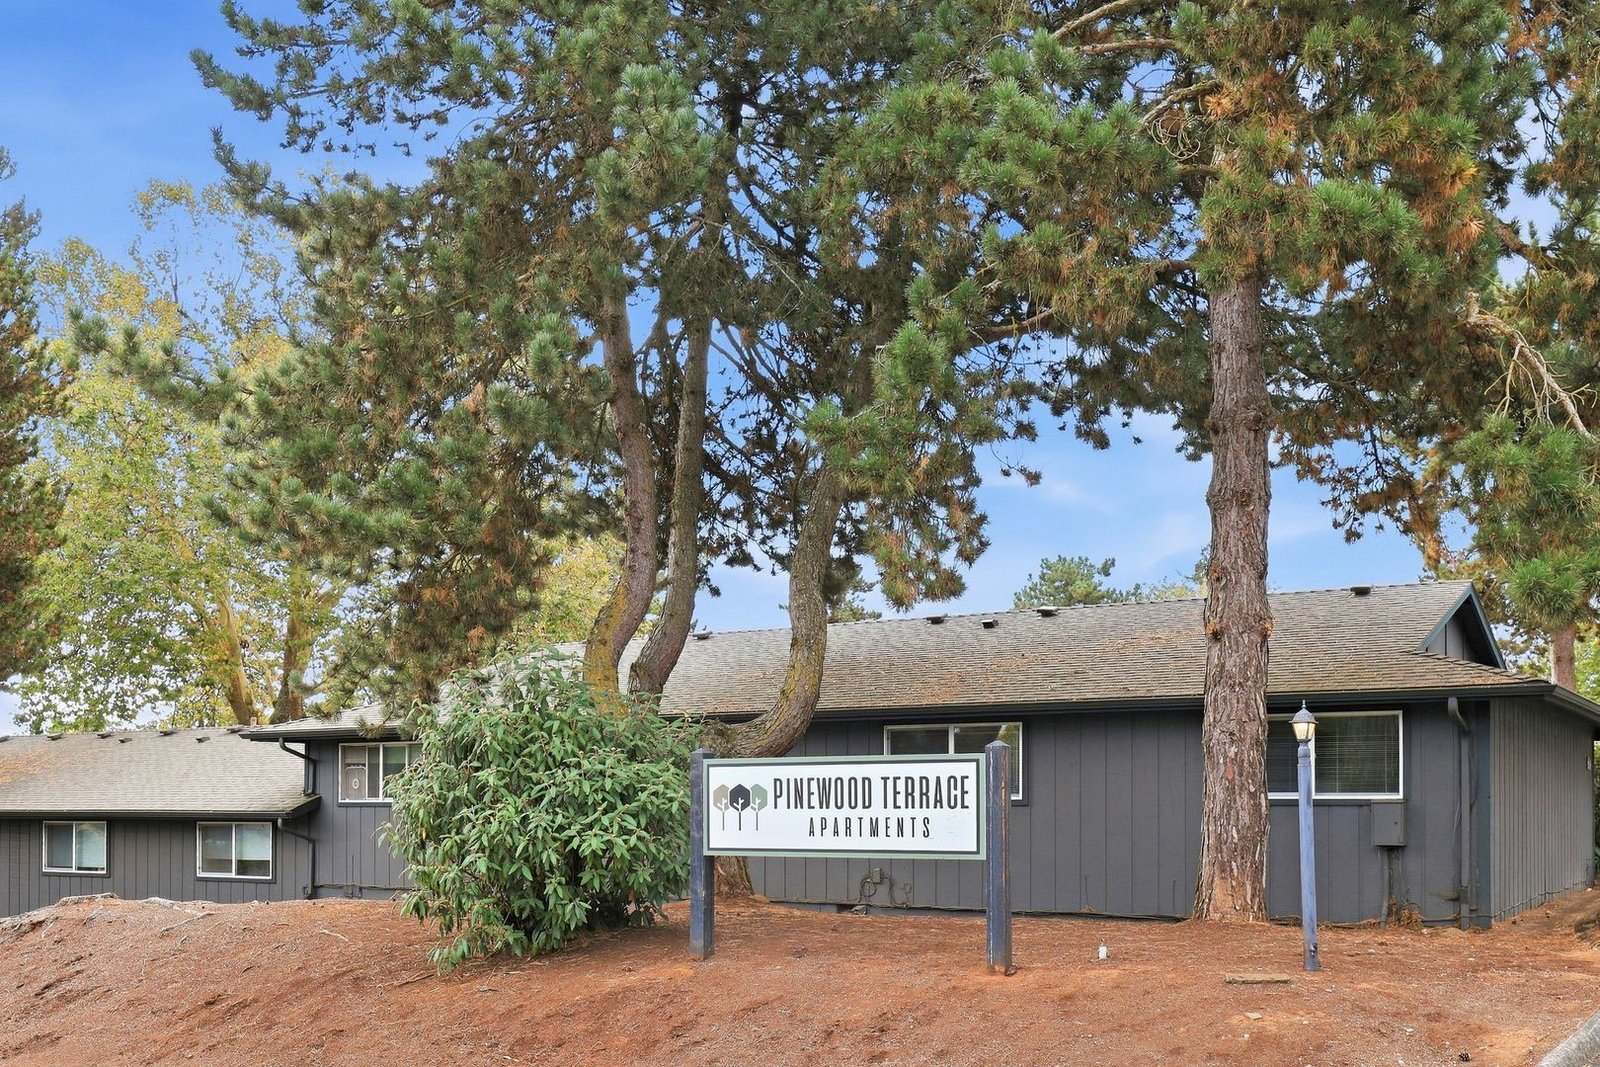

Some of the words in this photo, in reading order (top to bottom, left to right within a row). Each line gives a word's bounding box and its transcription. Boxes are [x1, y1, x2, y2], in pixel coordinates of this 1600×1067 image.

[773, 777, 872, 810] PINEWOOD
[880, 775, 970, 810] TERRACE
[808, 817, 931, 838] APARTMENTS
